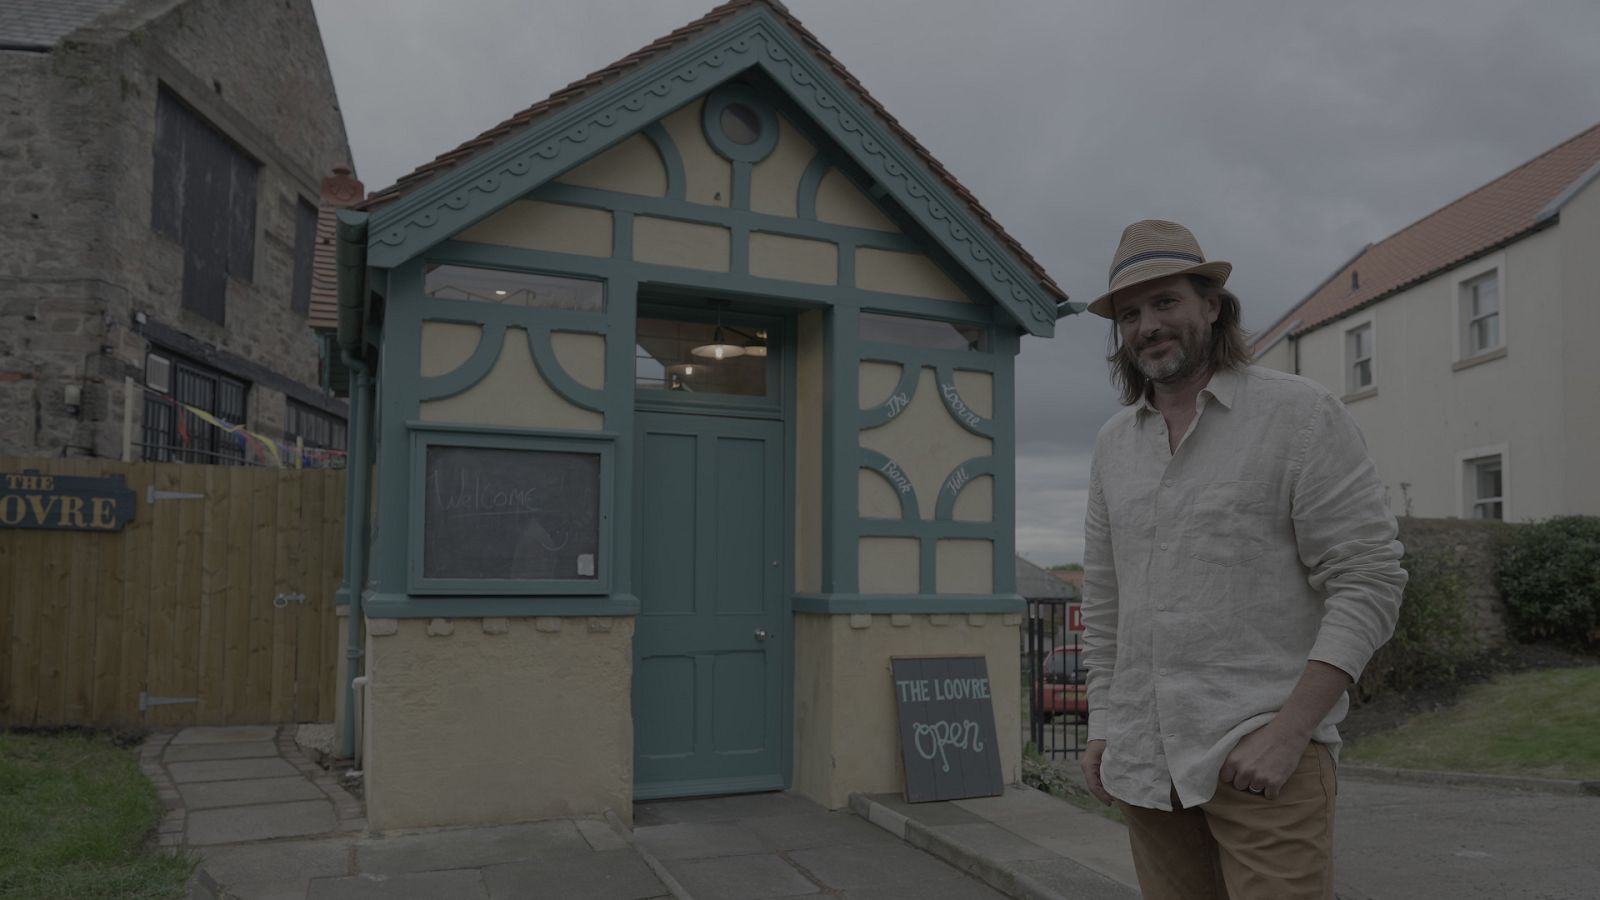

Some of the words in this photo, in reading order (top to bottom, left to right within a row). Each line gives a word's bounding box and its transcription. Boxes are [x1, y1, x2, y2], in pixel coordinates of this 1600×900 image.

[885, 392, 909, 418] The
[941, 383, 980, 428] Loovre
[6, 474, 55, 491] THE
[881, 459, 912, 494] Bank
[946, 466, 969, 496] Hill
[896, 680, 930, 702] THE
[934, 678, 992, 701] LOOVRE
